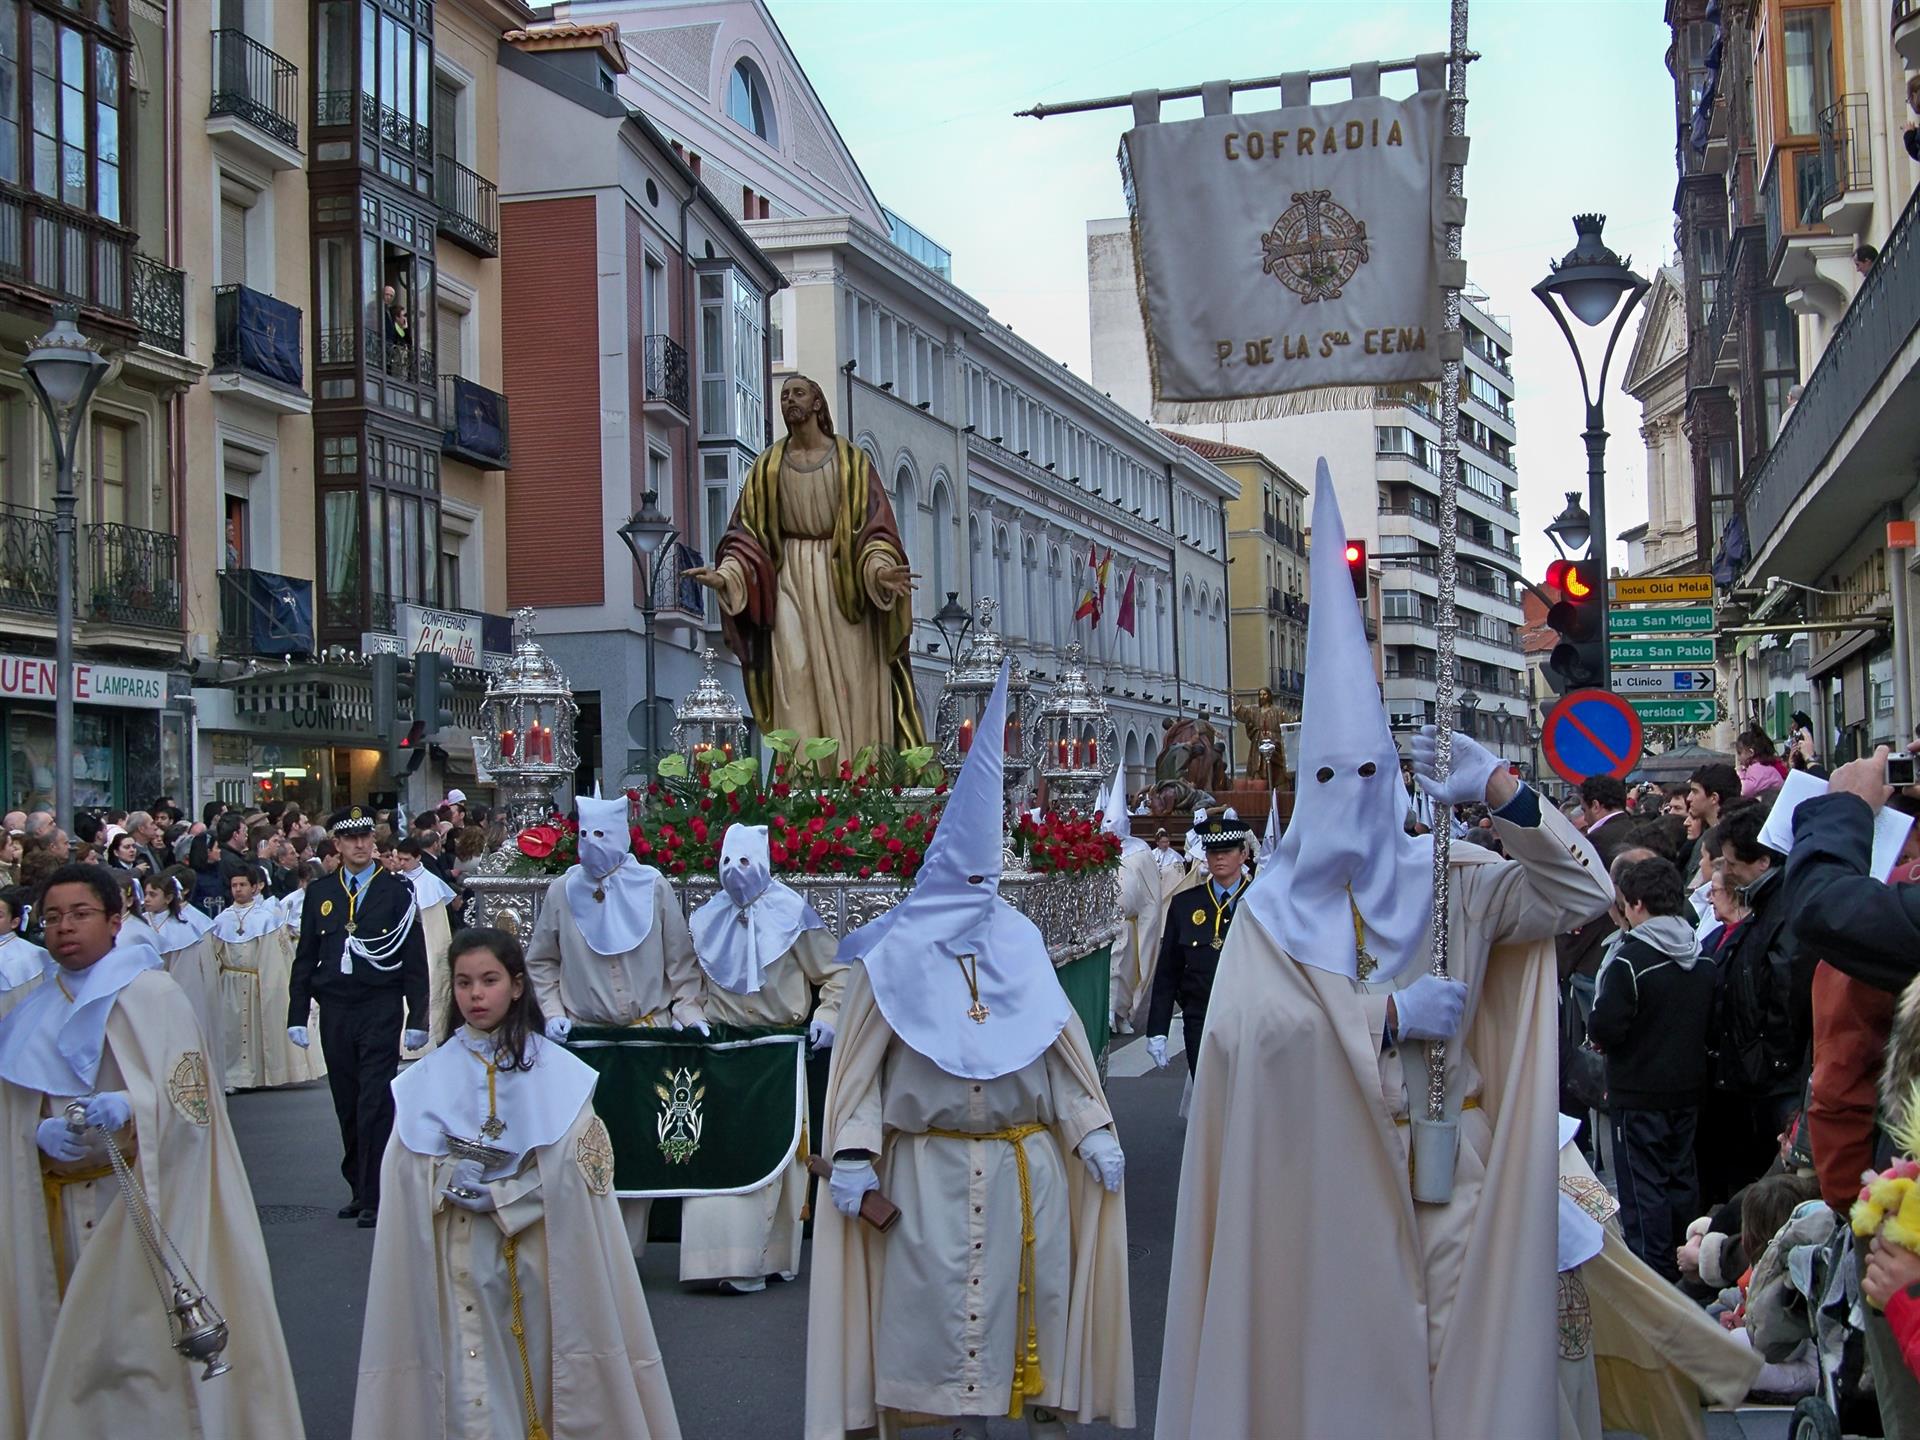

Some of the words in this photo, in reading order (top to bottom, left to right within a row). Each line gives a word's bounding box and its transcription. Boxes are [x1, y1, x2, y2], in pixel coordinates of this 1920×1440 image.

[1224, 117, 1403, 161] COFRADIA
[1216, 339, 1233, 368] P.
[1245, 337, 1274, 366] DE
[1283, 334, 1311, 361] LA
[1364, 325, 1426, 354] CENA
[1621, 586, 1646, 595] hotel
[1650, 583, 1674, 593] Olid
[421, 611, 467, 631] CONFITERIAS
[1643, 616, 1666, 626] San
[1671, 614, 1711, 627] Miguel
[1611, 647, 1643, 659] plaza
[1649, 647, 1672, 656] San
[1677, 646, 1712, 656] Pablo
[1, 659, 91, 698] UENE
[95, 674, 160, 699] LAMPARAS
